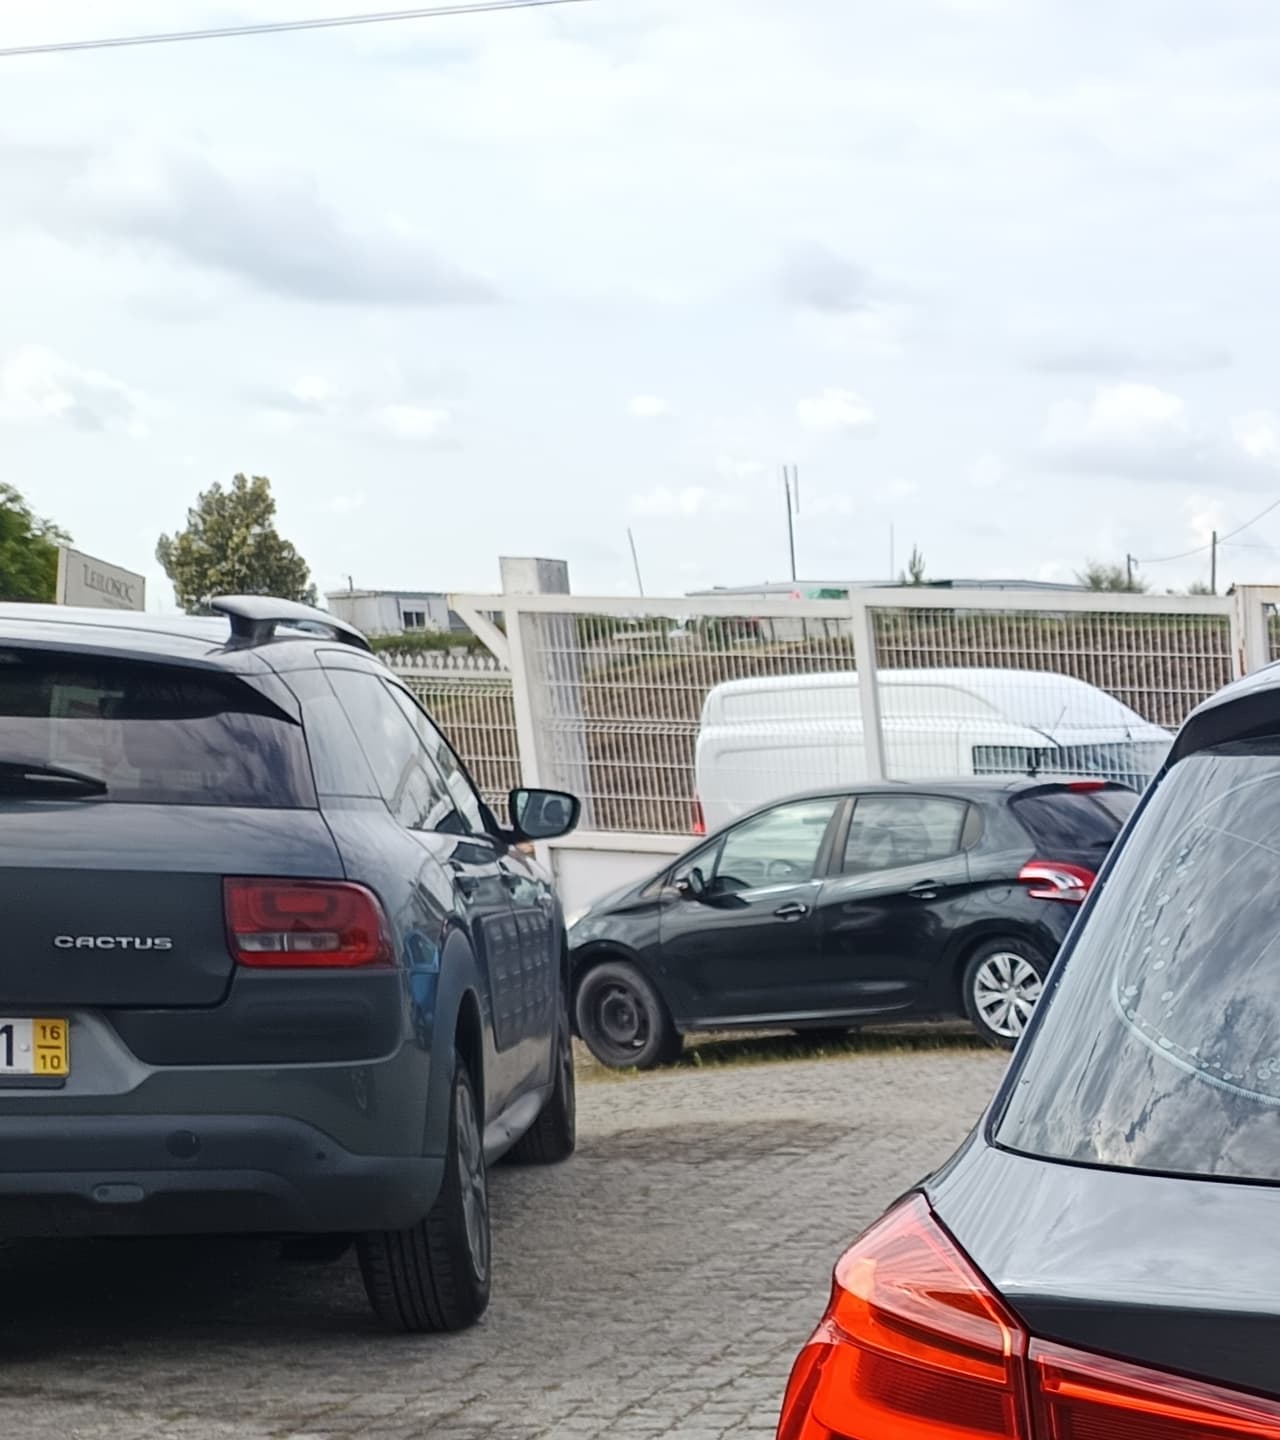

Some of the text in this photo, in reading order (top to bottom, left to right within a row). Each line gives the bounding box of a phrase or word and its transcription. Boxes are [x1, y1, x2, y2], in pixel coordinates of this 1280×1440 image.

[54, 935, 173, 950] CACTUS
[40, 1025, 61, 1040] 16
[41, 1054, 61, 1070] 10
